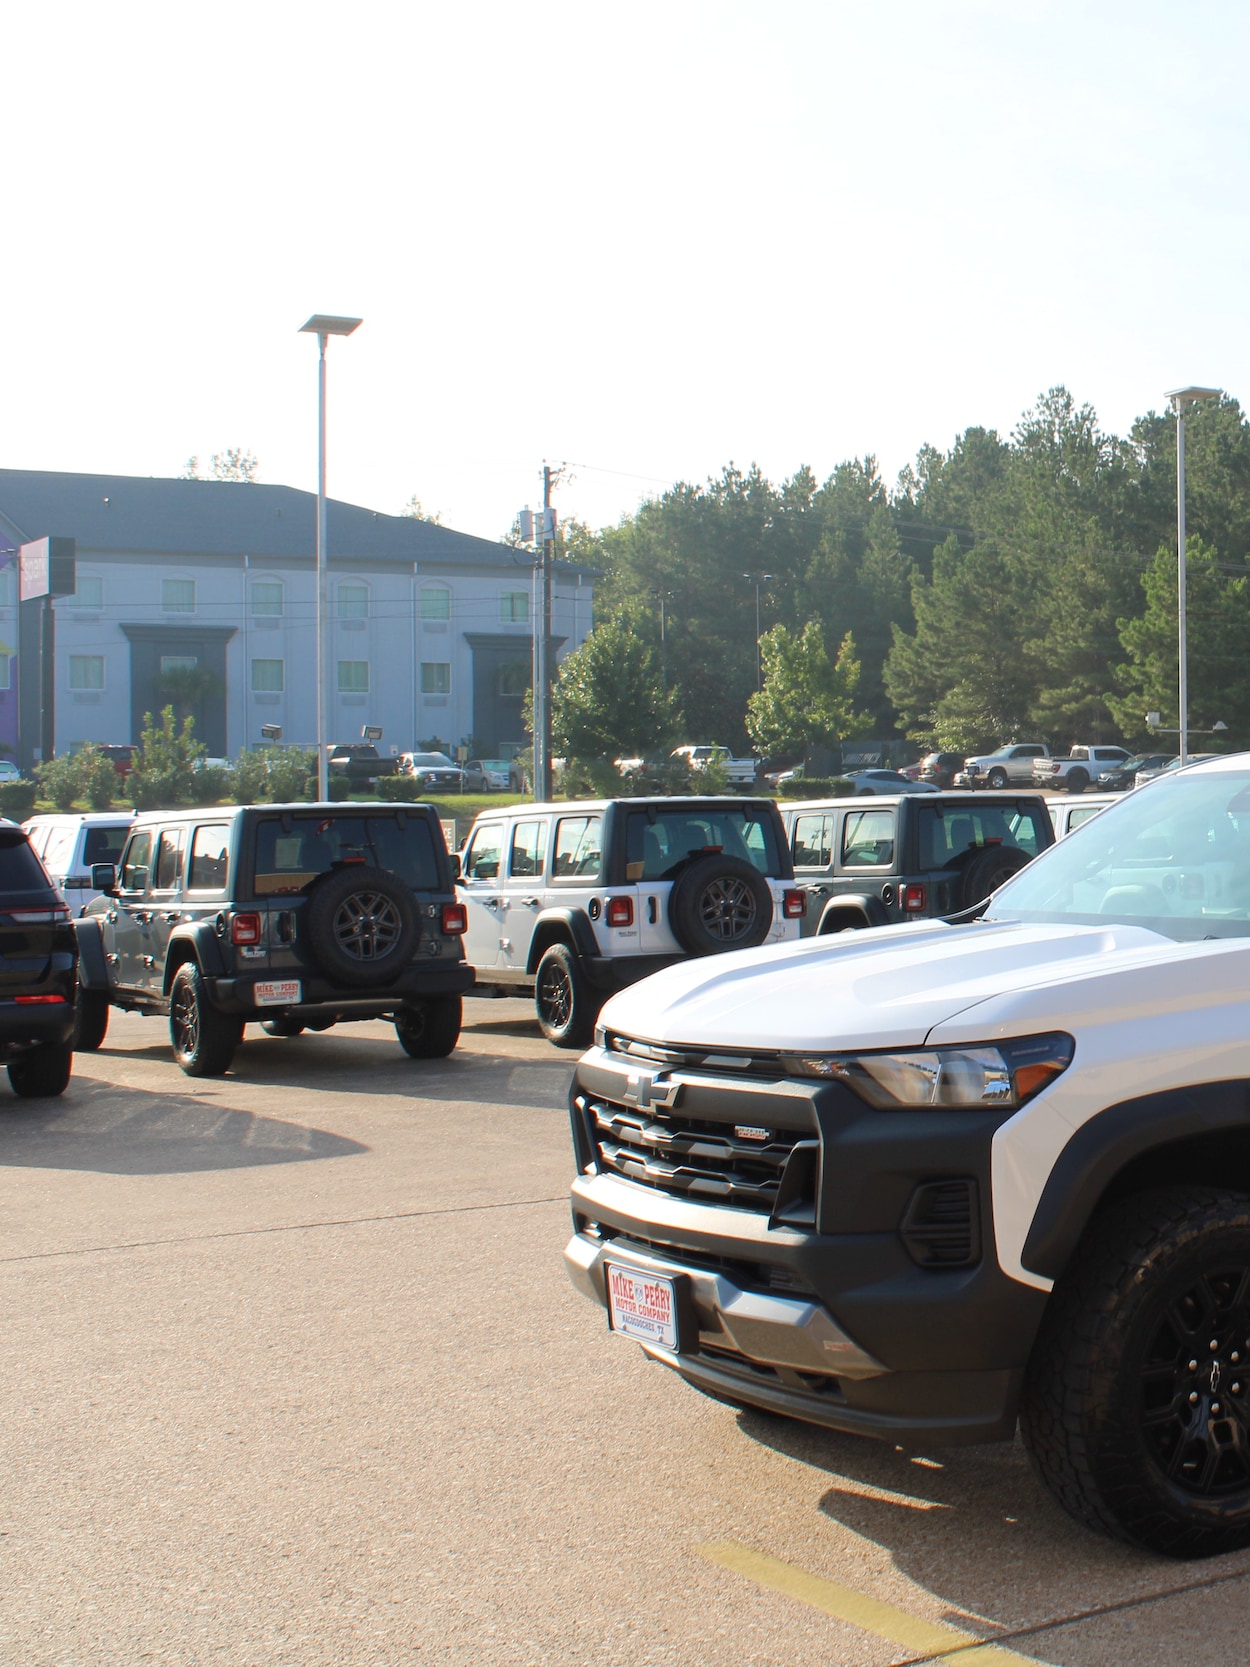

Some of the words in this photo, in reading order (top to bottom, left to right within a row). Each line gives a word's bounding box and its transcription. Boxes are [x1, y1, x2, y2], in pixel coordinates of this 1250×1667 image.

[612, 1274, 634, 1300] MIKE
[644, 1284, 671, 1311] PERRY
[615, 1297, 637, 1313] MOTOR
[638, 1304, 671, 1323] COMPANY
